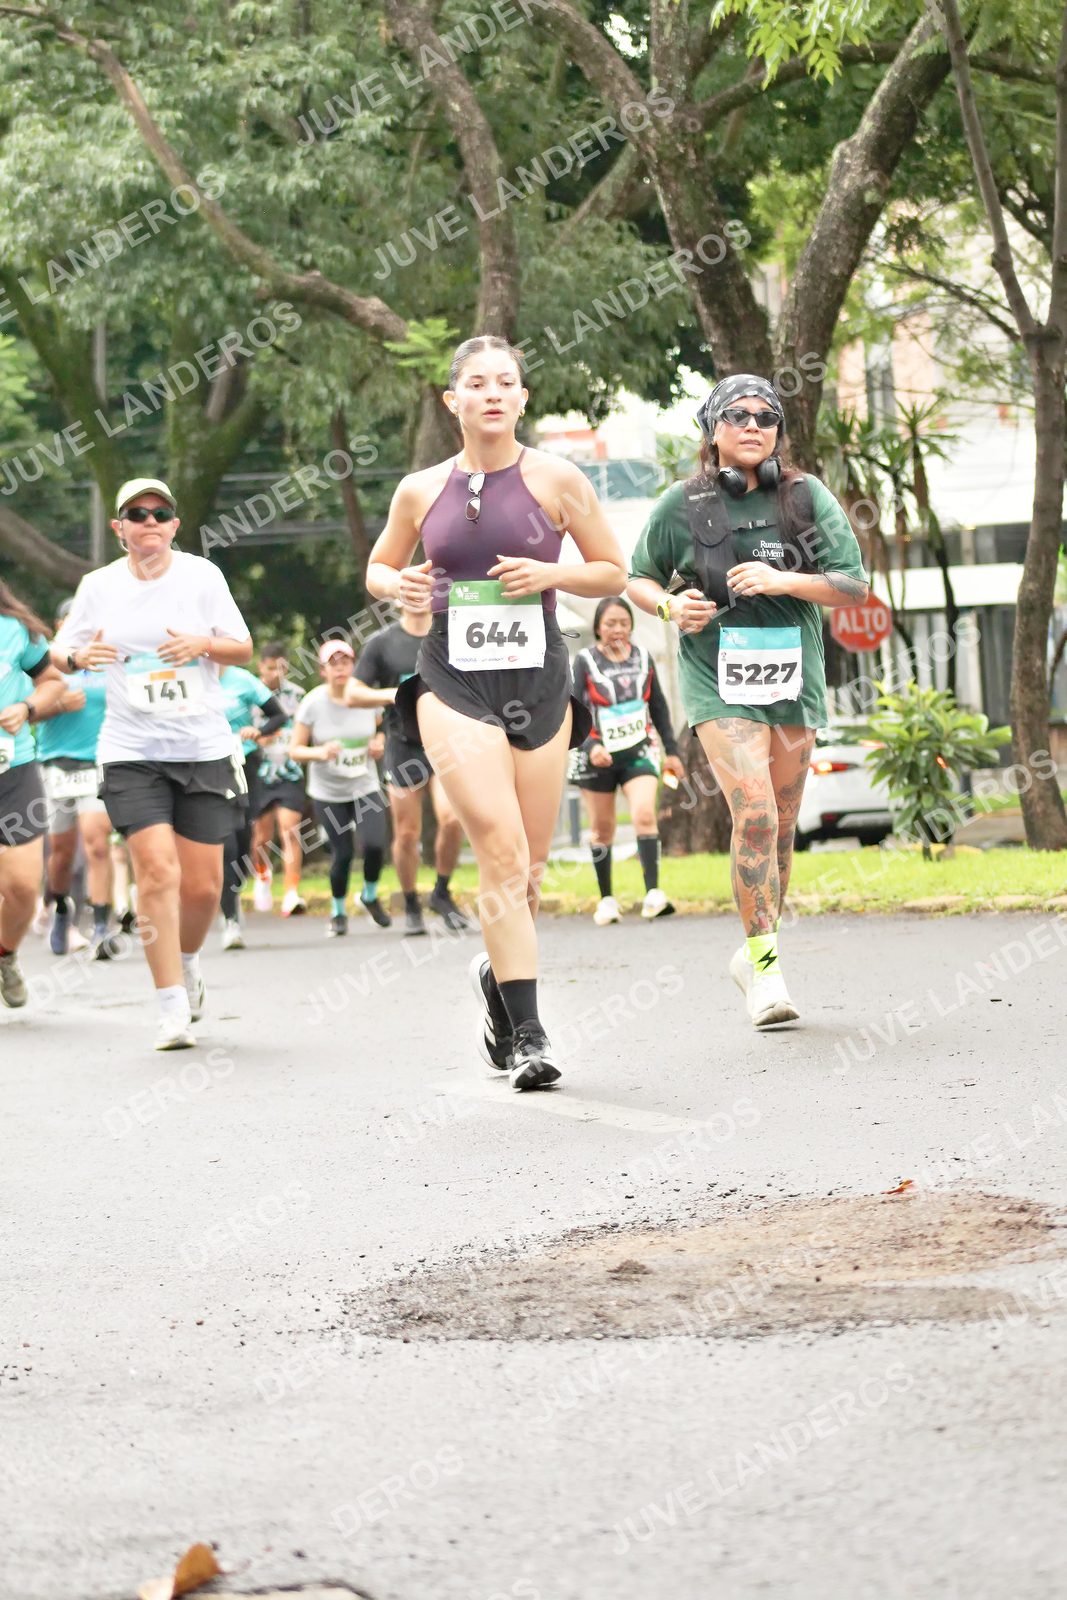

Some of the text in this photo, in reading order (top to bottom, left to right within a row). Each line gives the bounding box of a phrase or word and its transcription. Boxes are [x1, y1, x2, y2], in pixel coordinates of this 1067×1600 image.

[838, 607, 888, 633] ALTO
[466, 621, 528, 648] 644
[725, 662, 798, 686] 5227
[144, 680, 187, 703] 141
[606, 719, 643, 740] 2530
